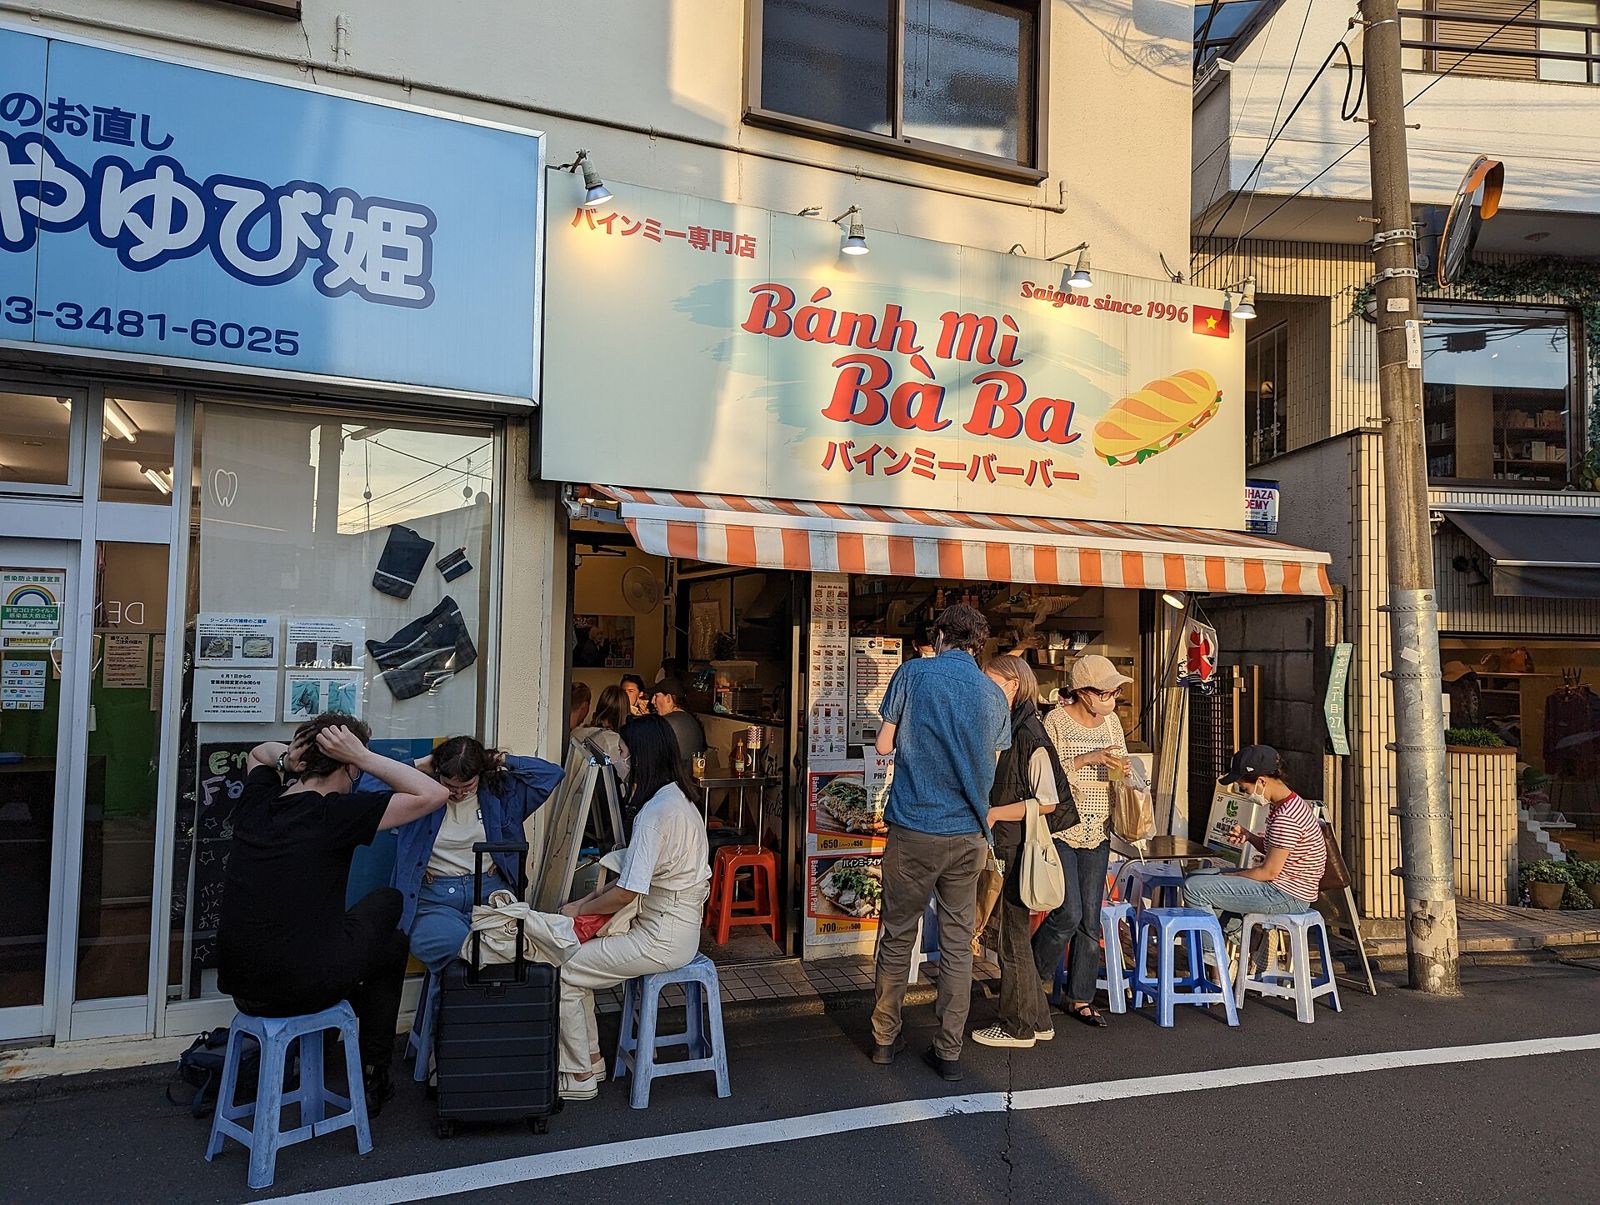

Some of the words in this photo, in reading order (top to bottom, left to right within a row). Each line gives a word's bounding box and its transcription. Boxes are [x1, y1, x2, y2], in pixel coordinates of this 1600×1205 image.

[0, 92, 174, 151] のお直し
[571, 207, 756, 259] バインミー専門店
[0, 296, 299, 356] 3-3481-6025
[740, 282, 924, 354] Bánh
[1020, 281, 1090, 308] Saigon
[1093, 294, 1143, 316] since
[1146, 301, 1189, 323] 1996
[821, 353, 953, 432] Bà
[962, 370, 1081, 445] Ba
[821, 440, 1080, 488] バインミーバーバー
[1328, 716, 1342, 728] 27
